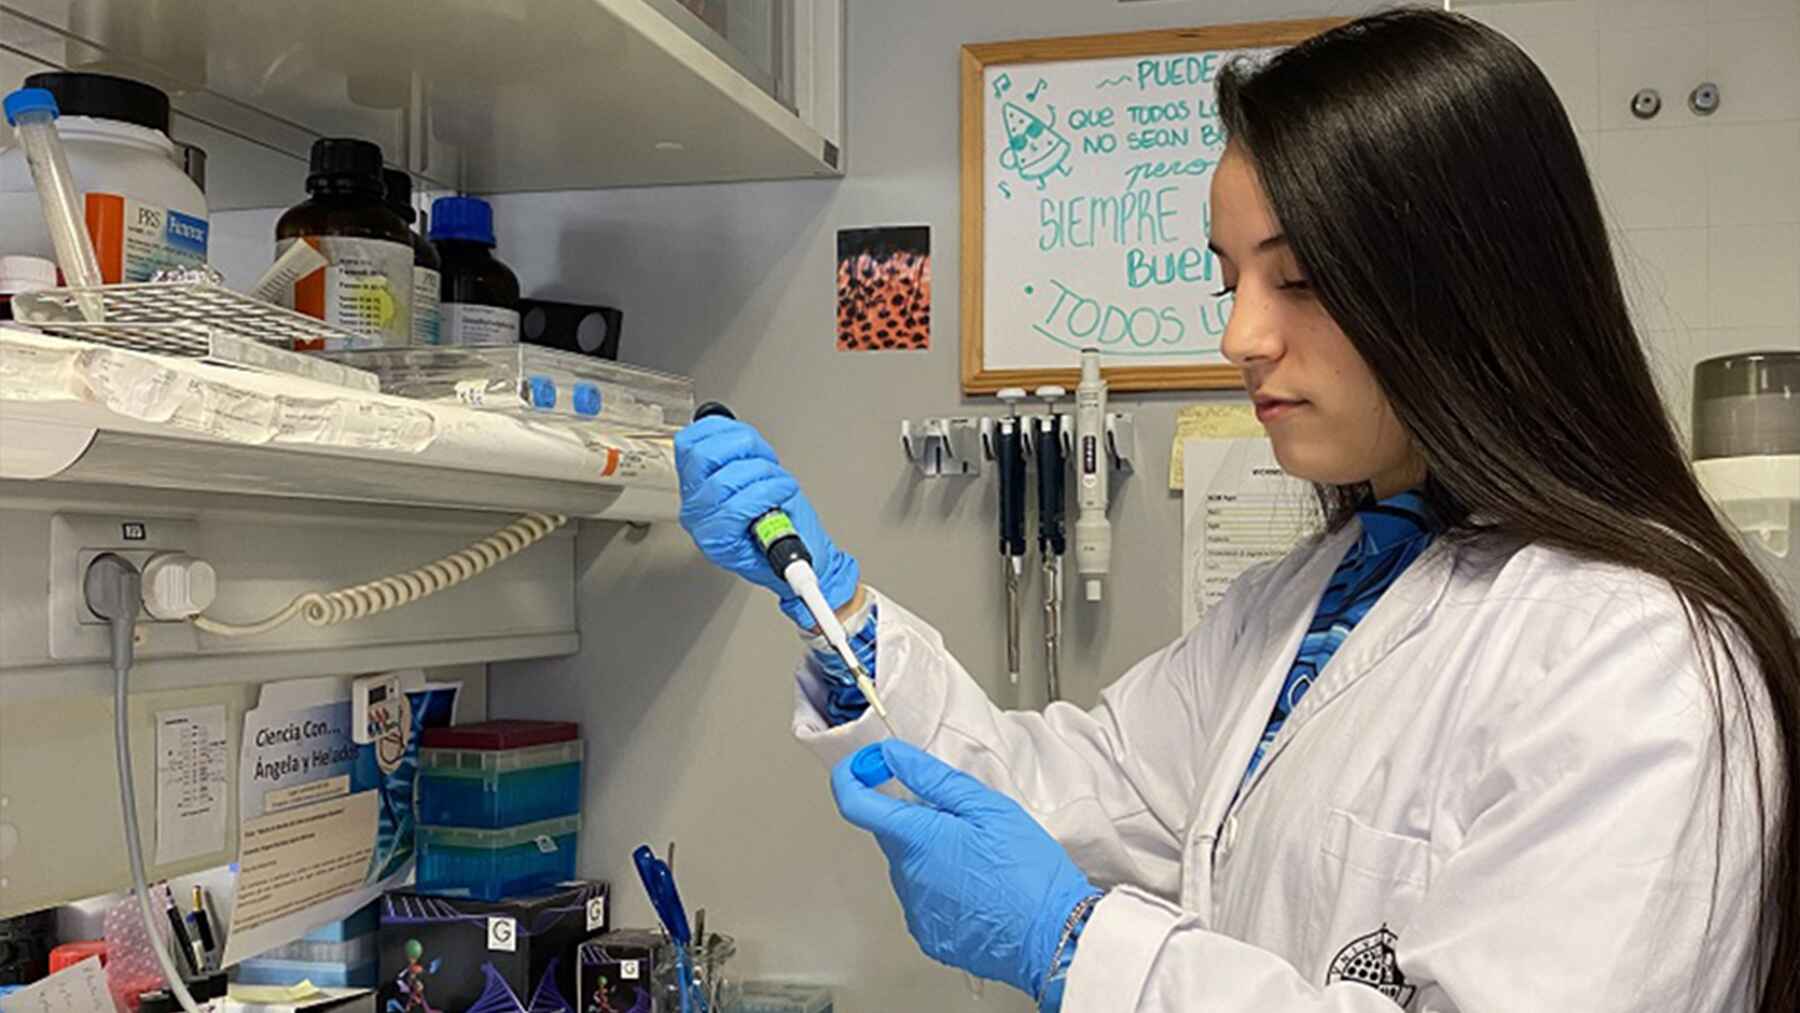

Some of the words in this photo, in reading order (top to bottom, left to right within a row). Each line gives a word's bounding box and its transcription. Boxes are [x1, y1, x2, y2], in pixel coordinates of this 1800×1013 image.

[1137, 54, 1218, 90] PUEDE
[1083, 133, 1117, 154] NO
[1125, 157, 1217, 192] pero
[1039, 187, 1179, 251] SIEMPRE
[1045, 279, 1185, 347] TODOS
[256, 723, 300, 748] Ciencia
[254, 755, 299, 781] Ángela
[302, 758, 309, 773] y
[589, 899, 601, 922] G
[493, 919, 512, 943] G
[623, 962, 636, 975] G
